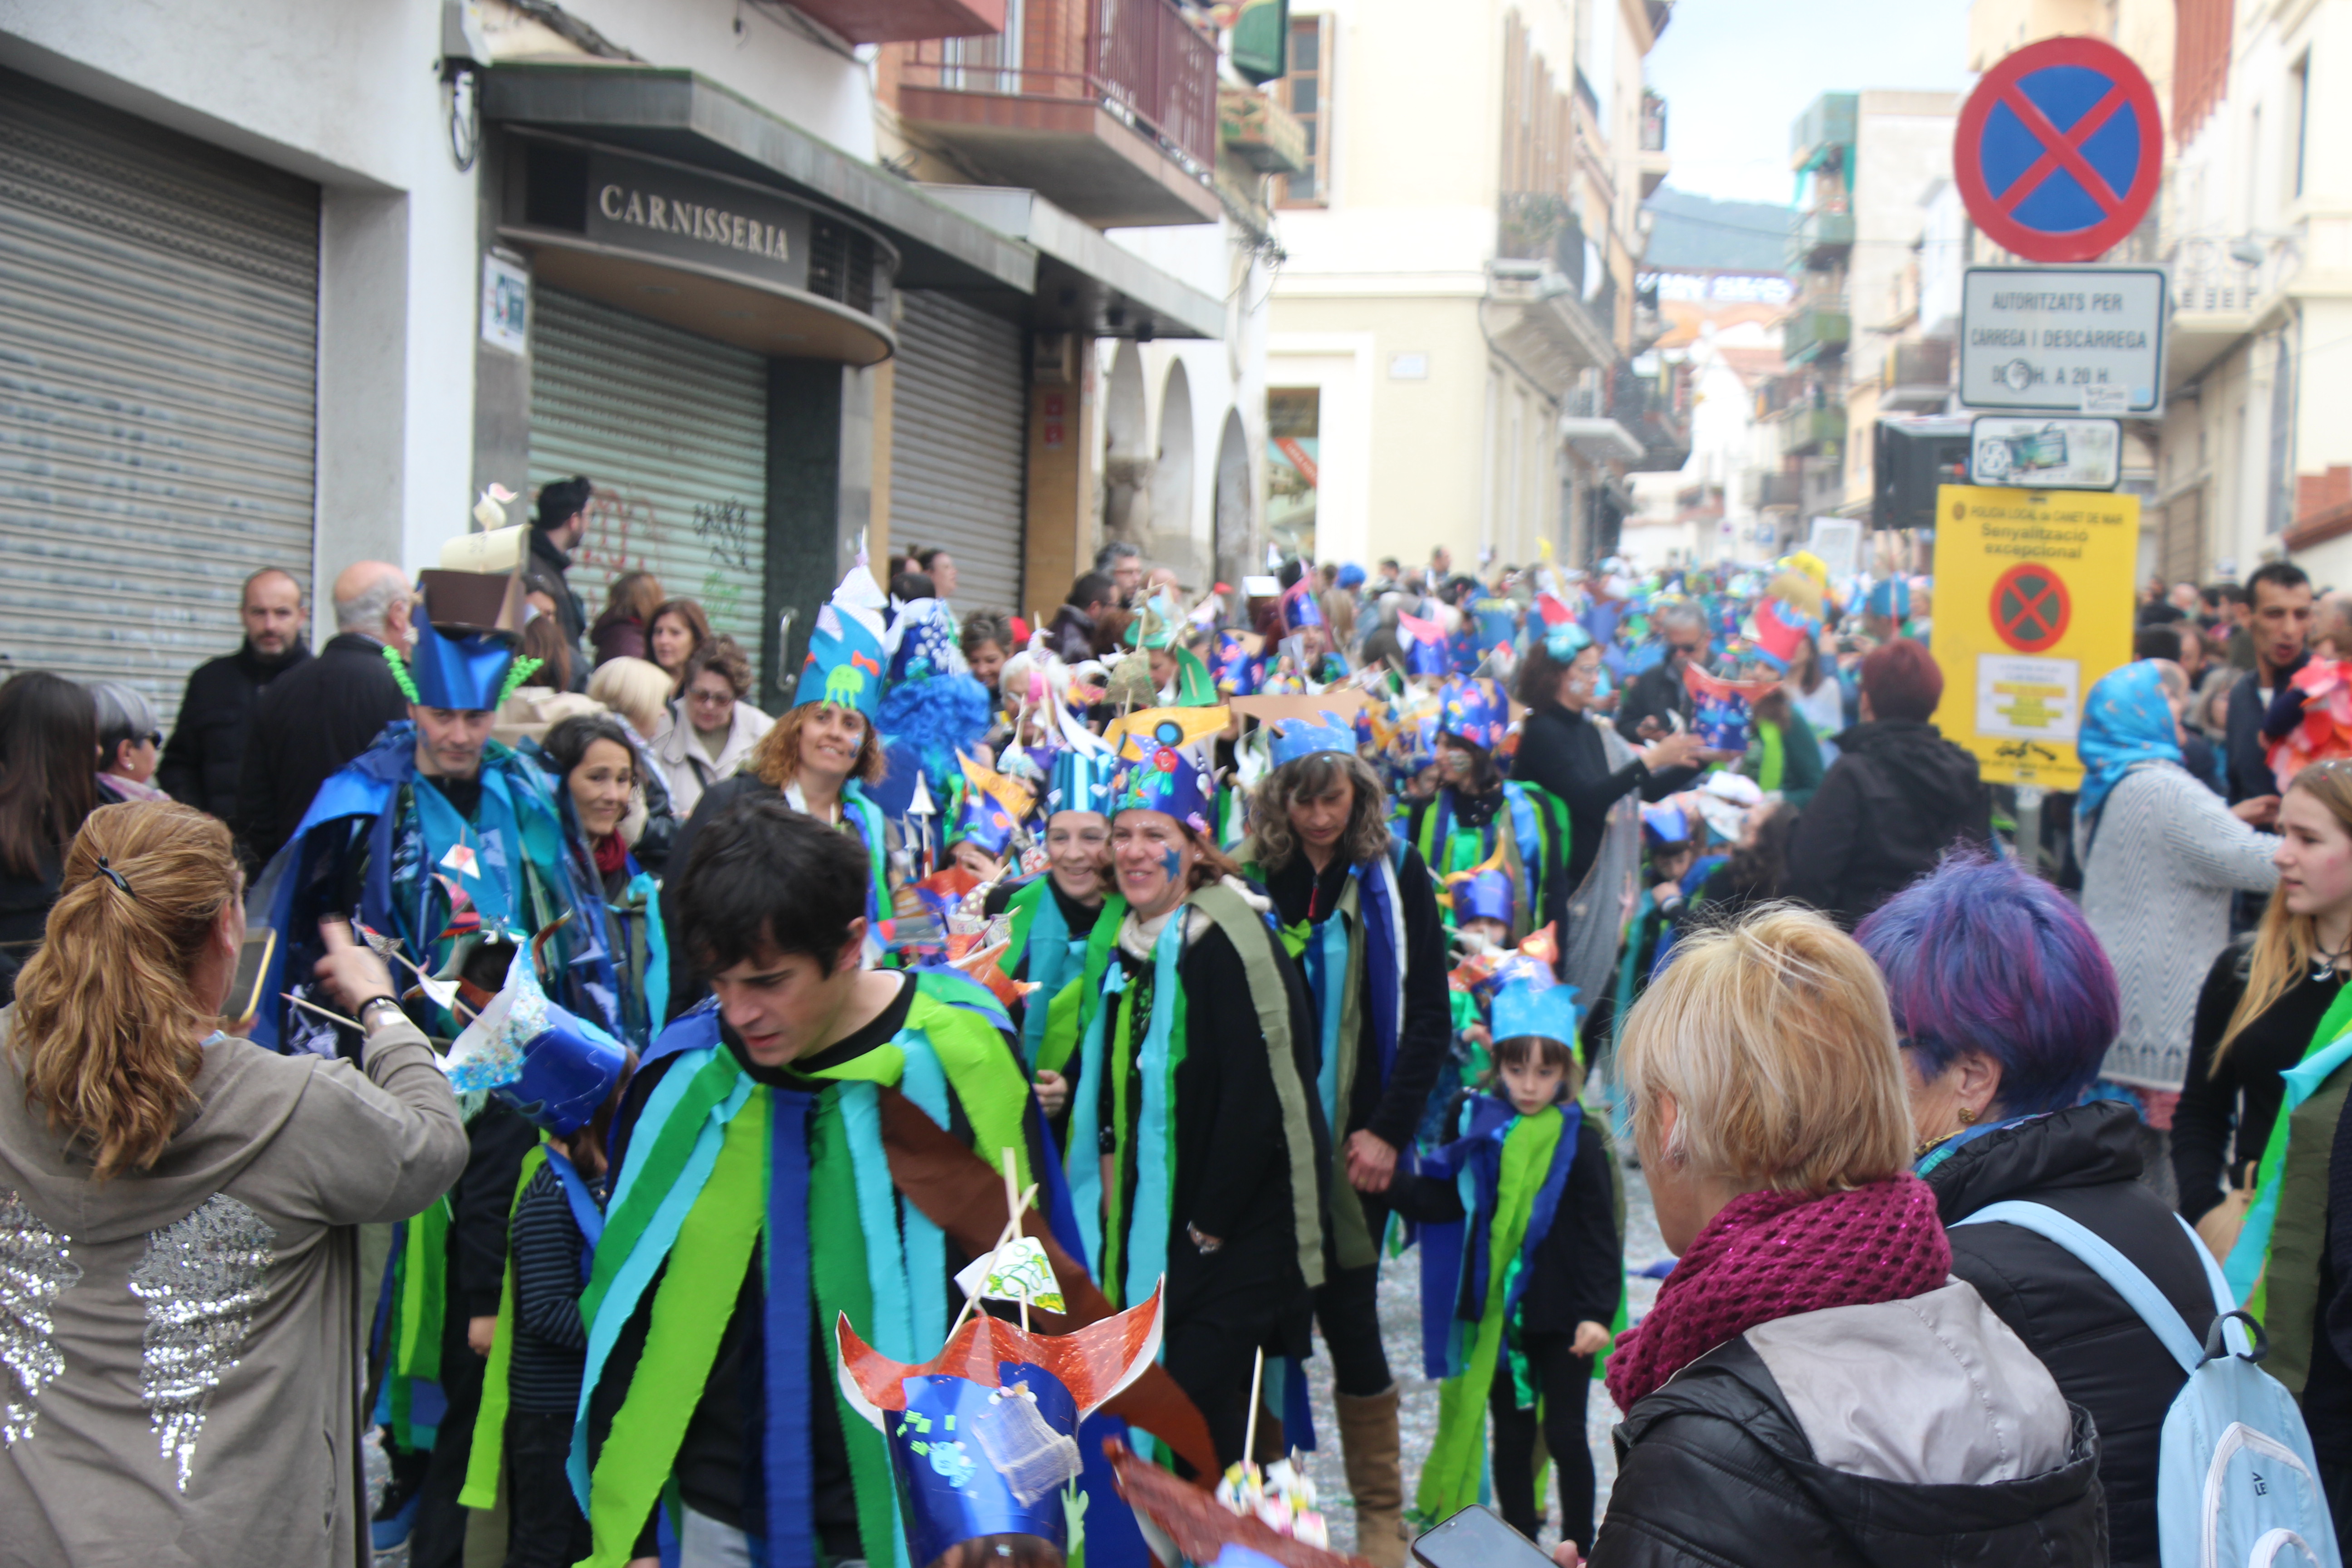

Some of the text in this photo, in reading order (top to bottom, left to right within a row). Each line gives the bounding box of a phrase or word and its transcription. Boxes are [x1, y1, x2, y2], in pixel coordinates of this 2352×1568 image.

[599, 184, 789, 262] CARNISSERIA
[1992, 292, 2123, 312] AUTORITZATS PER
[2031, 329, 2038, 347] I
[2055, 366, 2066, 384] A
[2072, 367, 2091, 384] 20
[1981, 522, 2089, 541] Senyalització
[1984, 542, 2082, 559] excepcional
